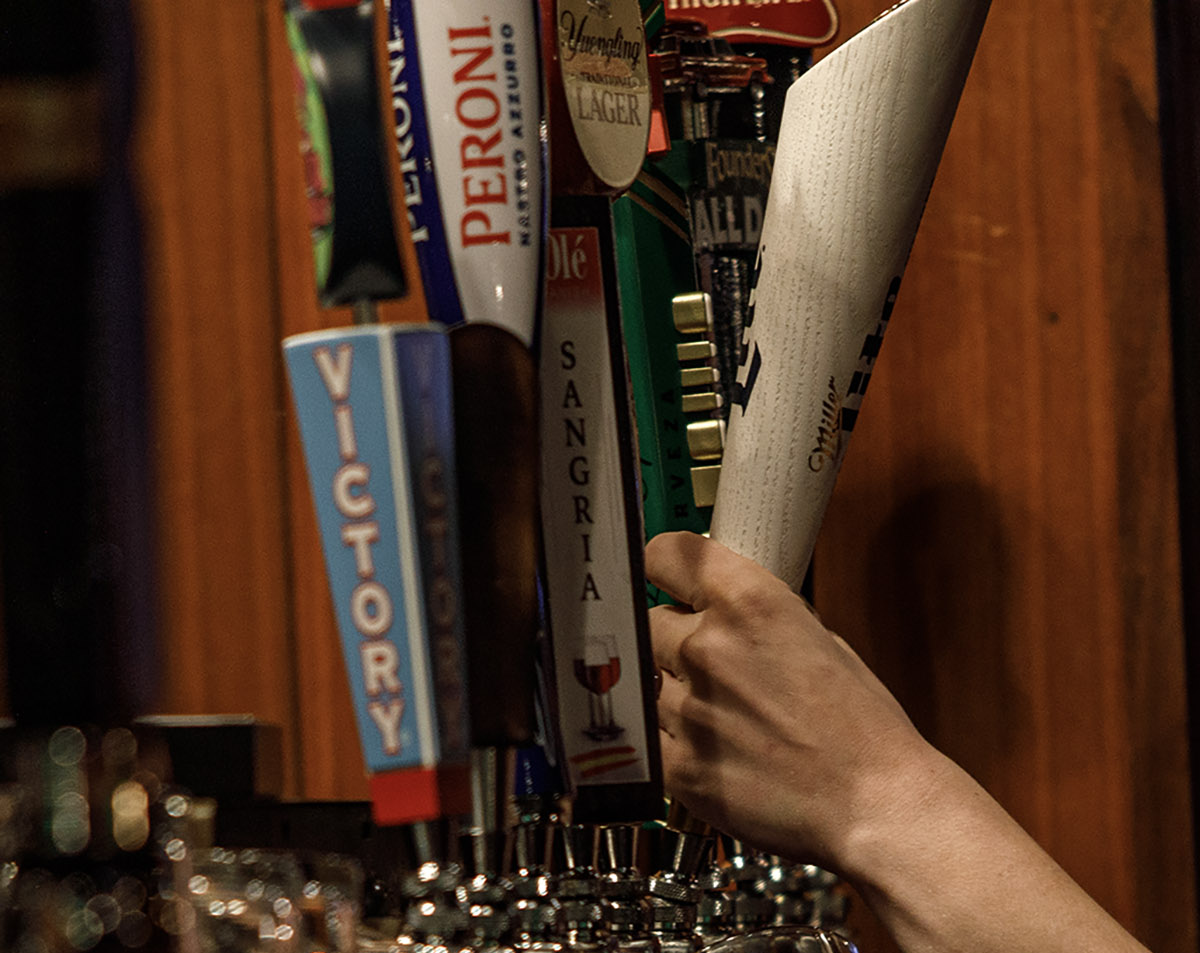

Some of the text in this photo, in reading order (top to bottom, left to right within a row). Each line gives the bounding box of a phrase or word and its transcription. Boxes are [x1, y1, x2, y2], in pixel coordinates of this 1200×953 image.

[561, 10, 643, 70] Yuengling
[576, 87, 641, 126] LAGER
[560, 340, 601, 602] SANGRIA
[661, 388, 690, 518] RVEZA
[808, 375, 842, 473] Miller
[313, 344, 405, 756] VICTORY
